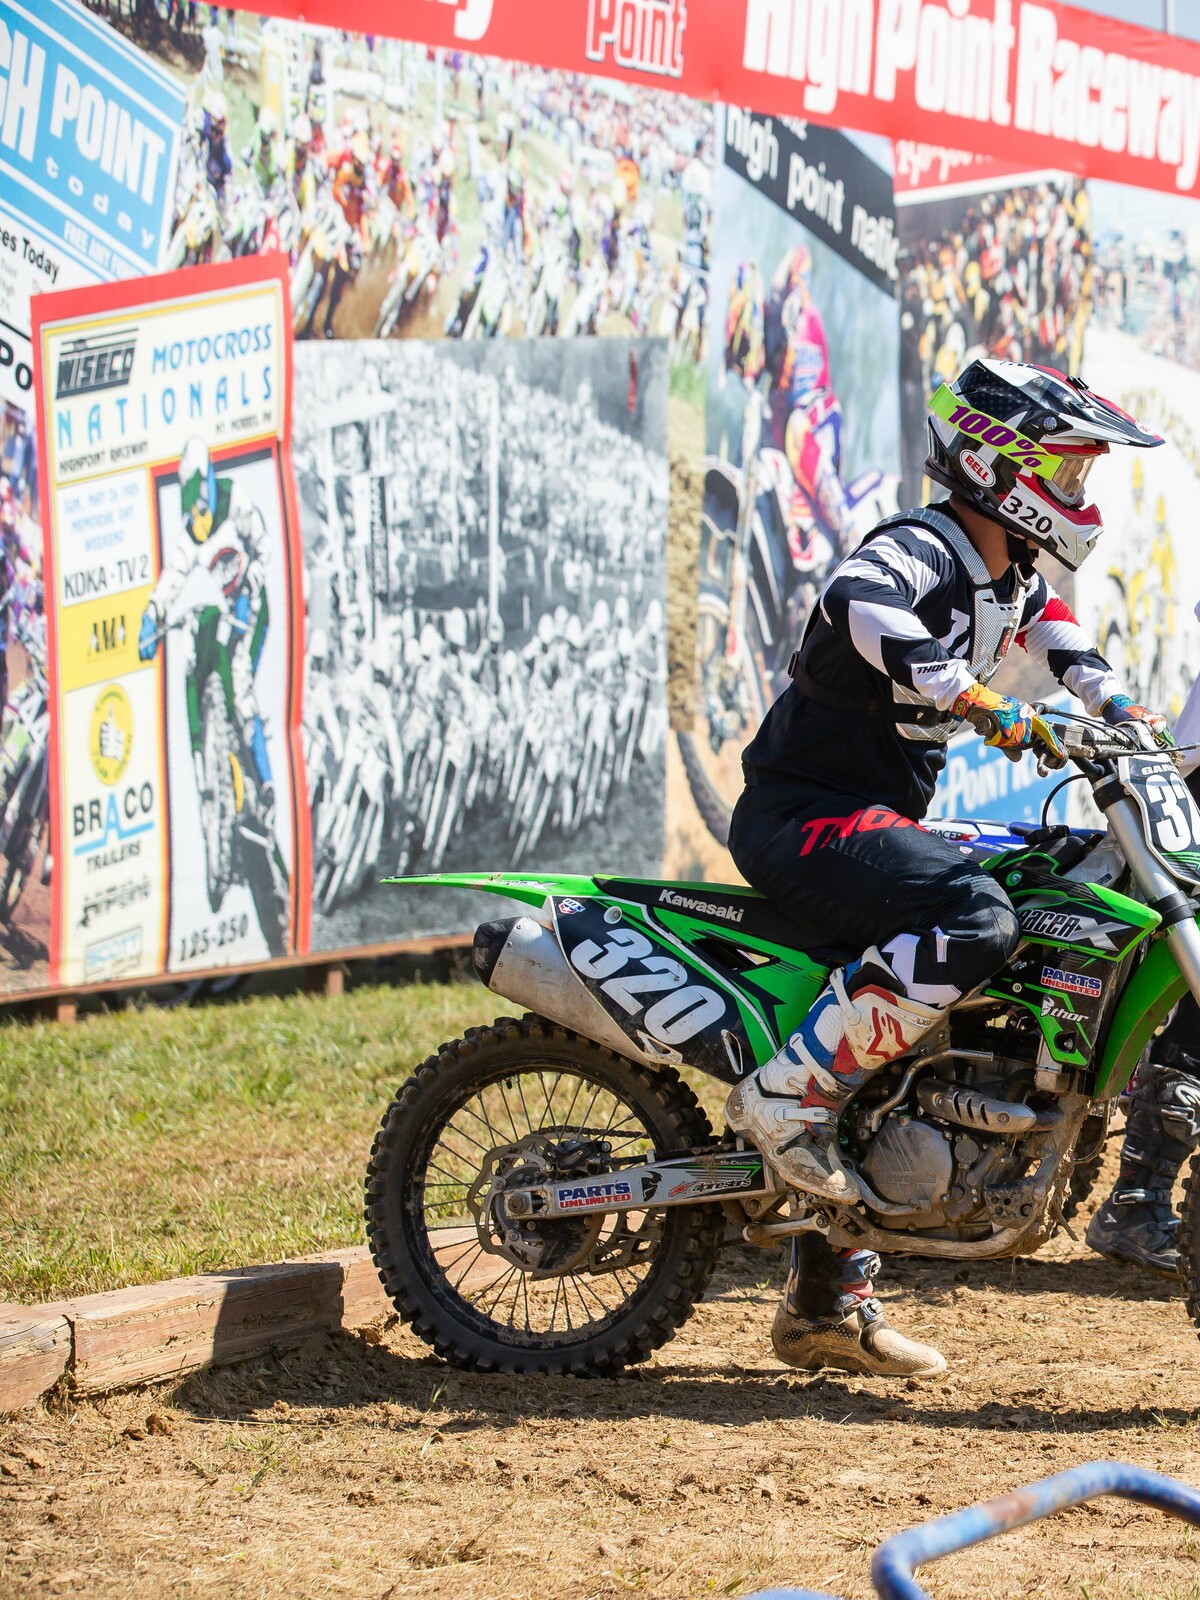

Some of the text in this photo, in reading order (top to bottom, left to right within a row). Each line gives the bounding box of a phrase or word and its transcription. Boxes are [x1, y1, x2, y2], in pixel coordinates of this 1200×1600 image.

[873, 0, 1014, 126] Point
[50, 62, 166, 206] POINT
[726, 103, 779, 182] high
[786, 152, 845, 234] point
[45, 155, 155, 250] today
[22, 237, 60, 284] Today
[152, 323, 273, 373] MOTOCROSS
[57, 366, 273, 450] NATIONALS
[947, 404, 1044, 469] 100%
[964, 455, 989, 483] BELL
[1002, 495, 1053, 535] 320
[916, 662, 949, 675] THOR
[73, 782, 154, 837] BRACO
[799, 809, 930, 858] THOR
[86, 840, 142, 873] TRAILERS
[658, 888, 745, 923] Kawasaki
[179, 913, 250, 962] 125-250
[570, 928, 727, 1045] 320
[1041, 977, 1101, 997] UNLIMITED
[1042, 967, 1101, 991] PARTS
[1051, 1007, 1090, 1023] thor
[558, 1181, 632, 1200] PARTS
[559, 1193, 632, 1209] UNLIMITED
